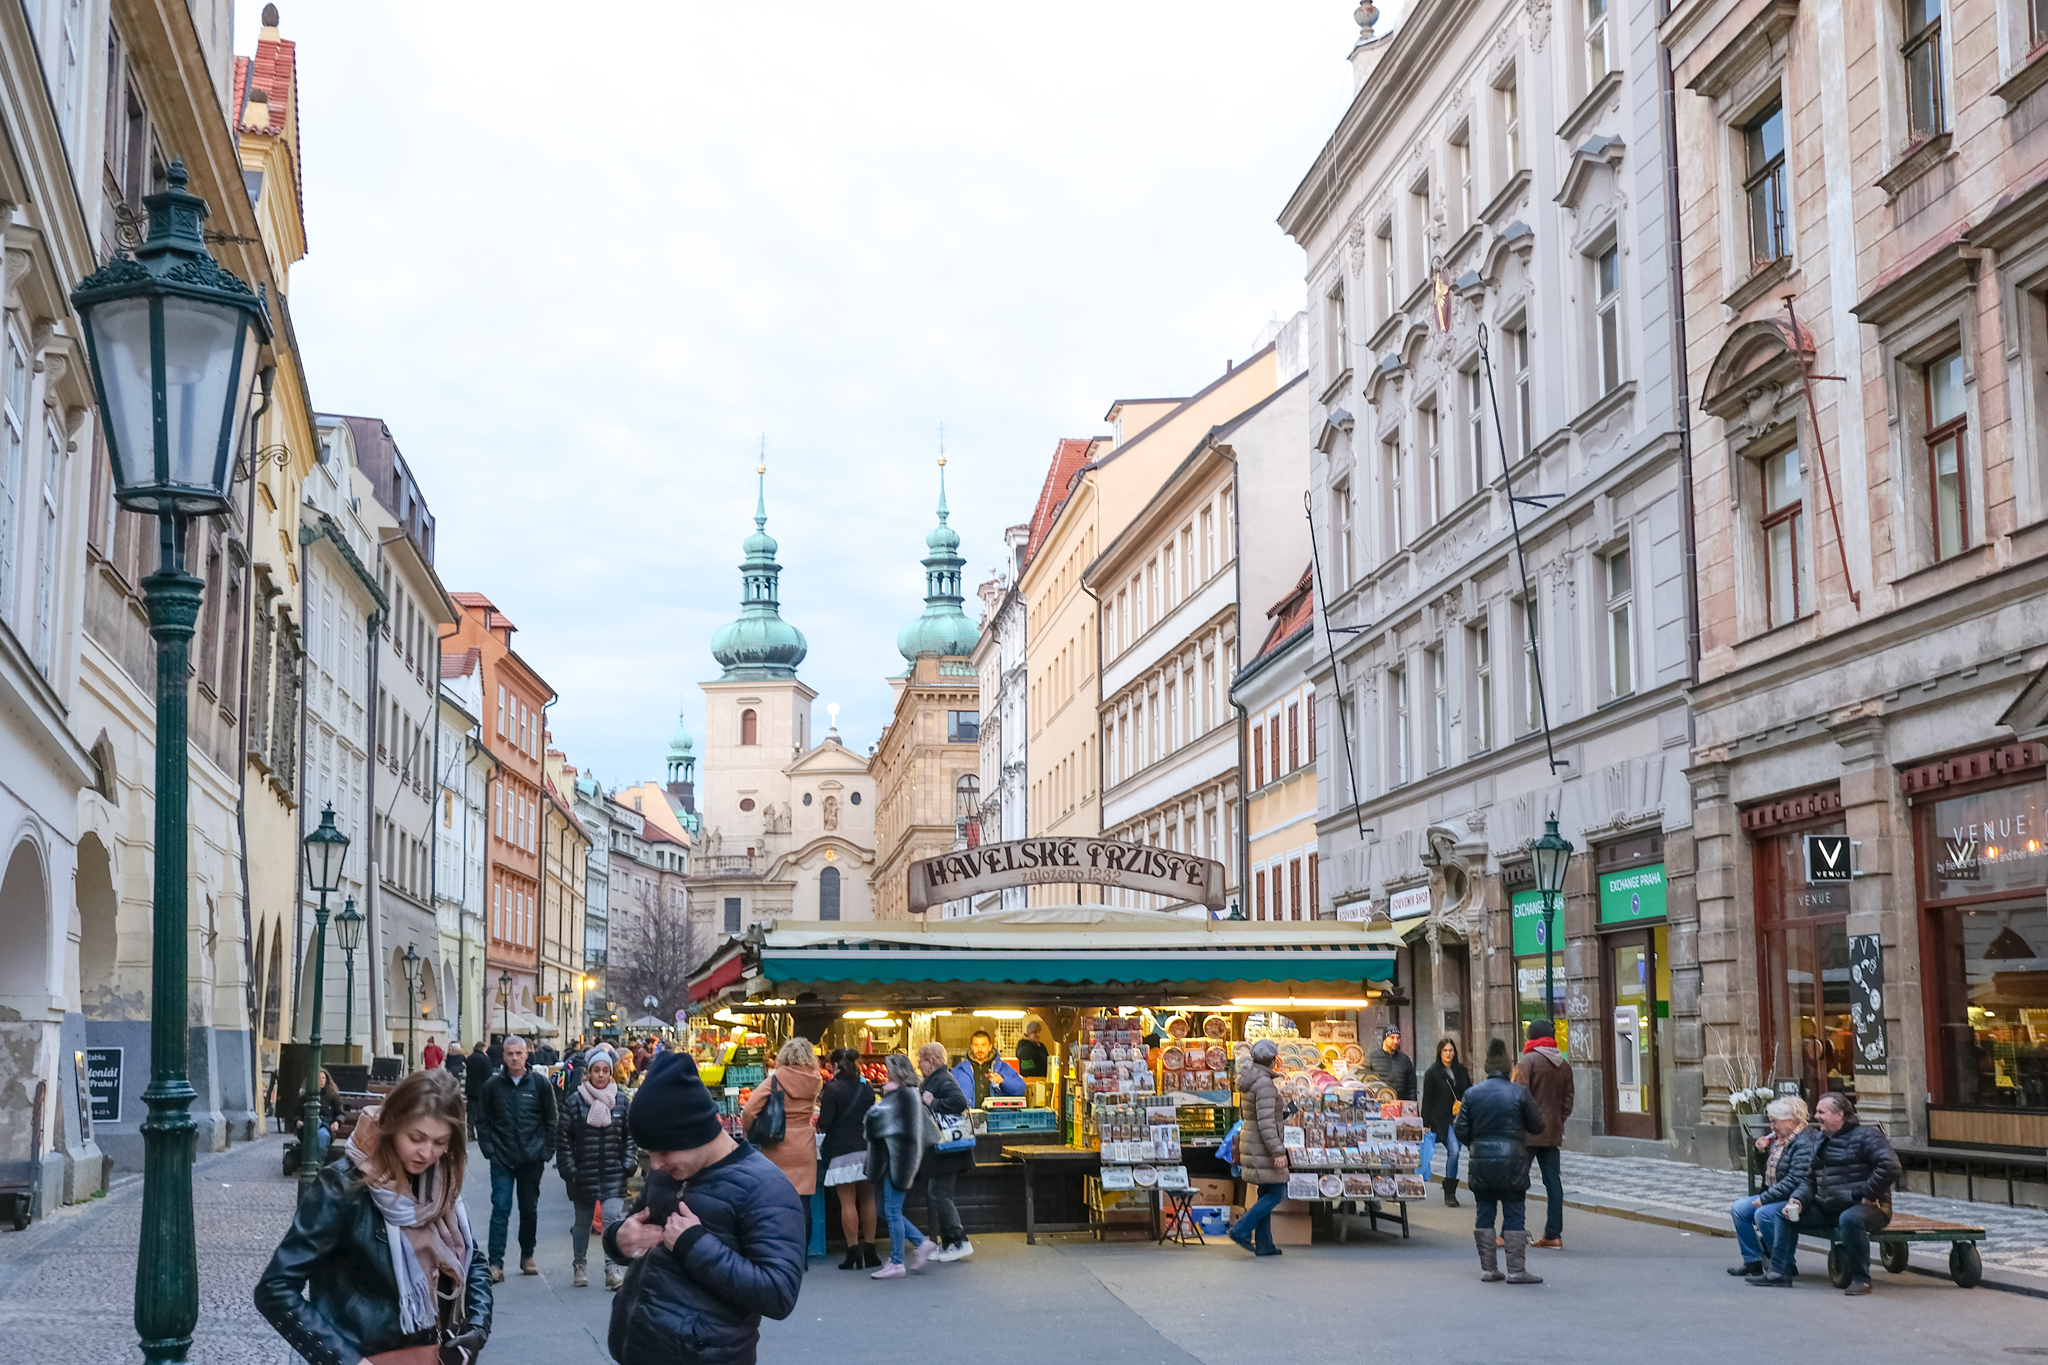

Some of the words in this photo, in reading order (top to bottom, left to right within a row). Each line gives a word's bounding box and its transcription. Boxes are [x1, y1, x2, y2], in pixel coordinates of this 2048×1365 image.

[1953, 814, 2026, 847] VENUE
[926, 838, 1081, 887] HAVELSKÉ
[1086, 842, 1205, 887] TRŽIŠTĚ
[1818, 839, 1842, 869] V
[1087, 868, 1122, 883] 1232
[1609, 875, 1640, 893] EXCHANGE
[1640, 871, 1662, 887] PRAHA
[1816, 870, 1846, 878] VENUE
[1798, 891, 1832, 907] VENUE
